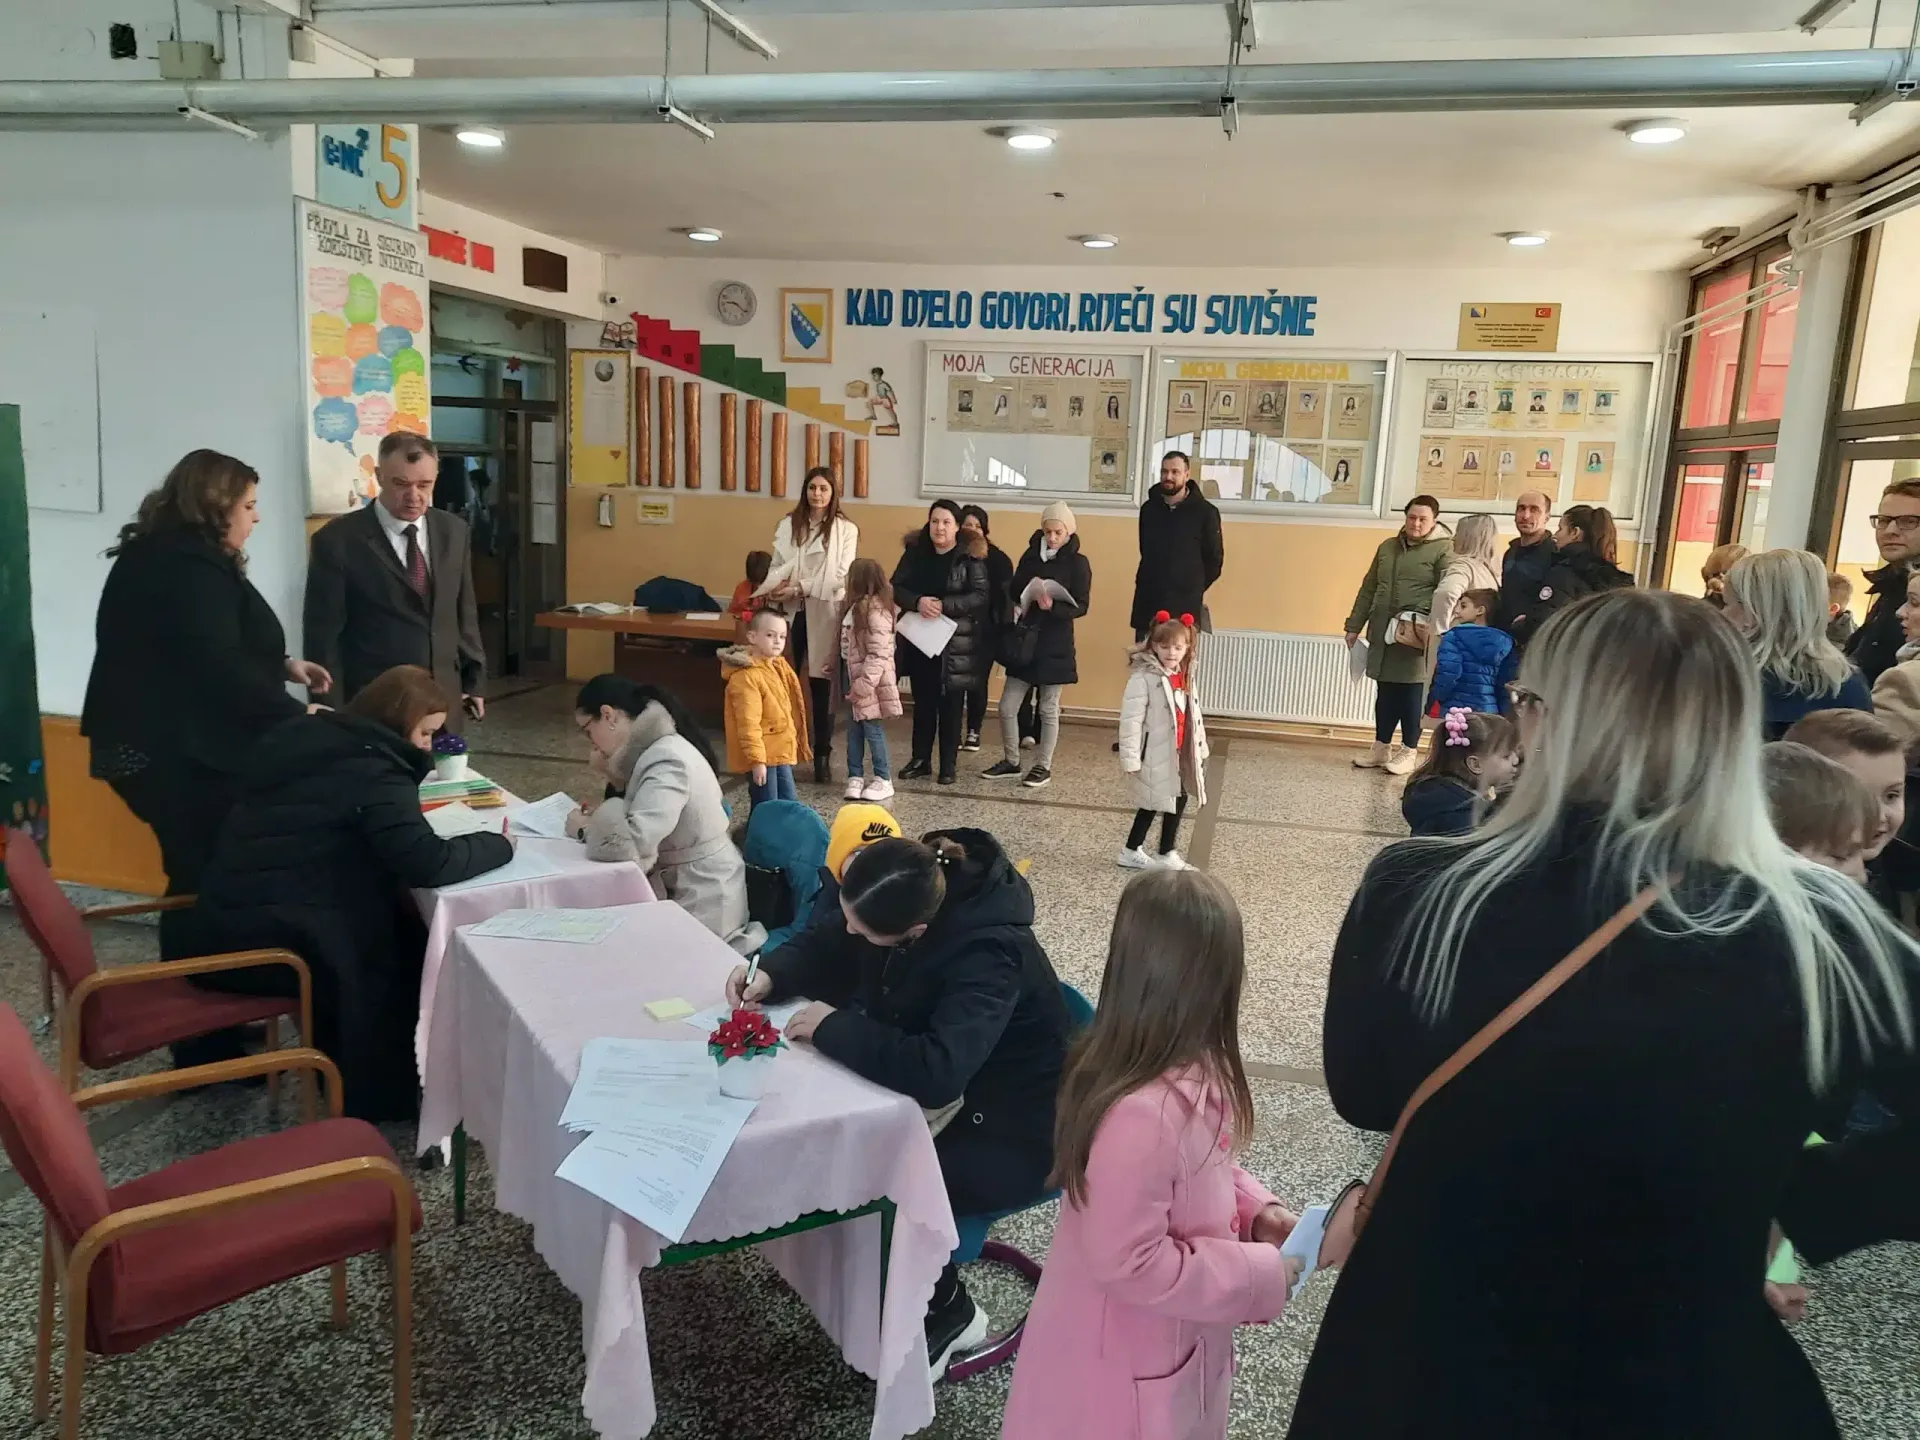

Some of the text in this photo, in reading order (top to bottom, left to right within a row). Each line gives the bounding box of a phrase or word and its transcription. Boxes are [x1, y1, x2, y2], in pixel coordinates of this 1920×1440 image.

[307, 212, 416, 259] PRAVILA ZA SIGURNO
[379, 251, 425, 277] INTERNETA
[846, 288, 894, 327] KAD
[902, 289, 972, 329] DJELO
[1078, 286, 1155, 332] RIJEČI
[1162, 294, 1197, 333] SU
[1204, 288, 1317, 336] SUVIŠNE
[943, 353, 1115, 377] MOJA GENERACIJA
[1181, 361, 1349, 381] MOJA GENERACIJA
[1440, 363, 1488, 378] MOJA
[866, 821, 893, 837] NIKE
